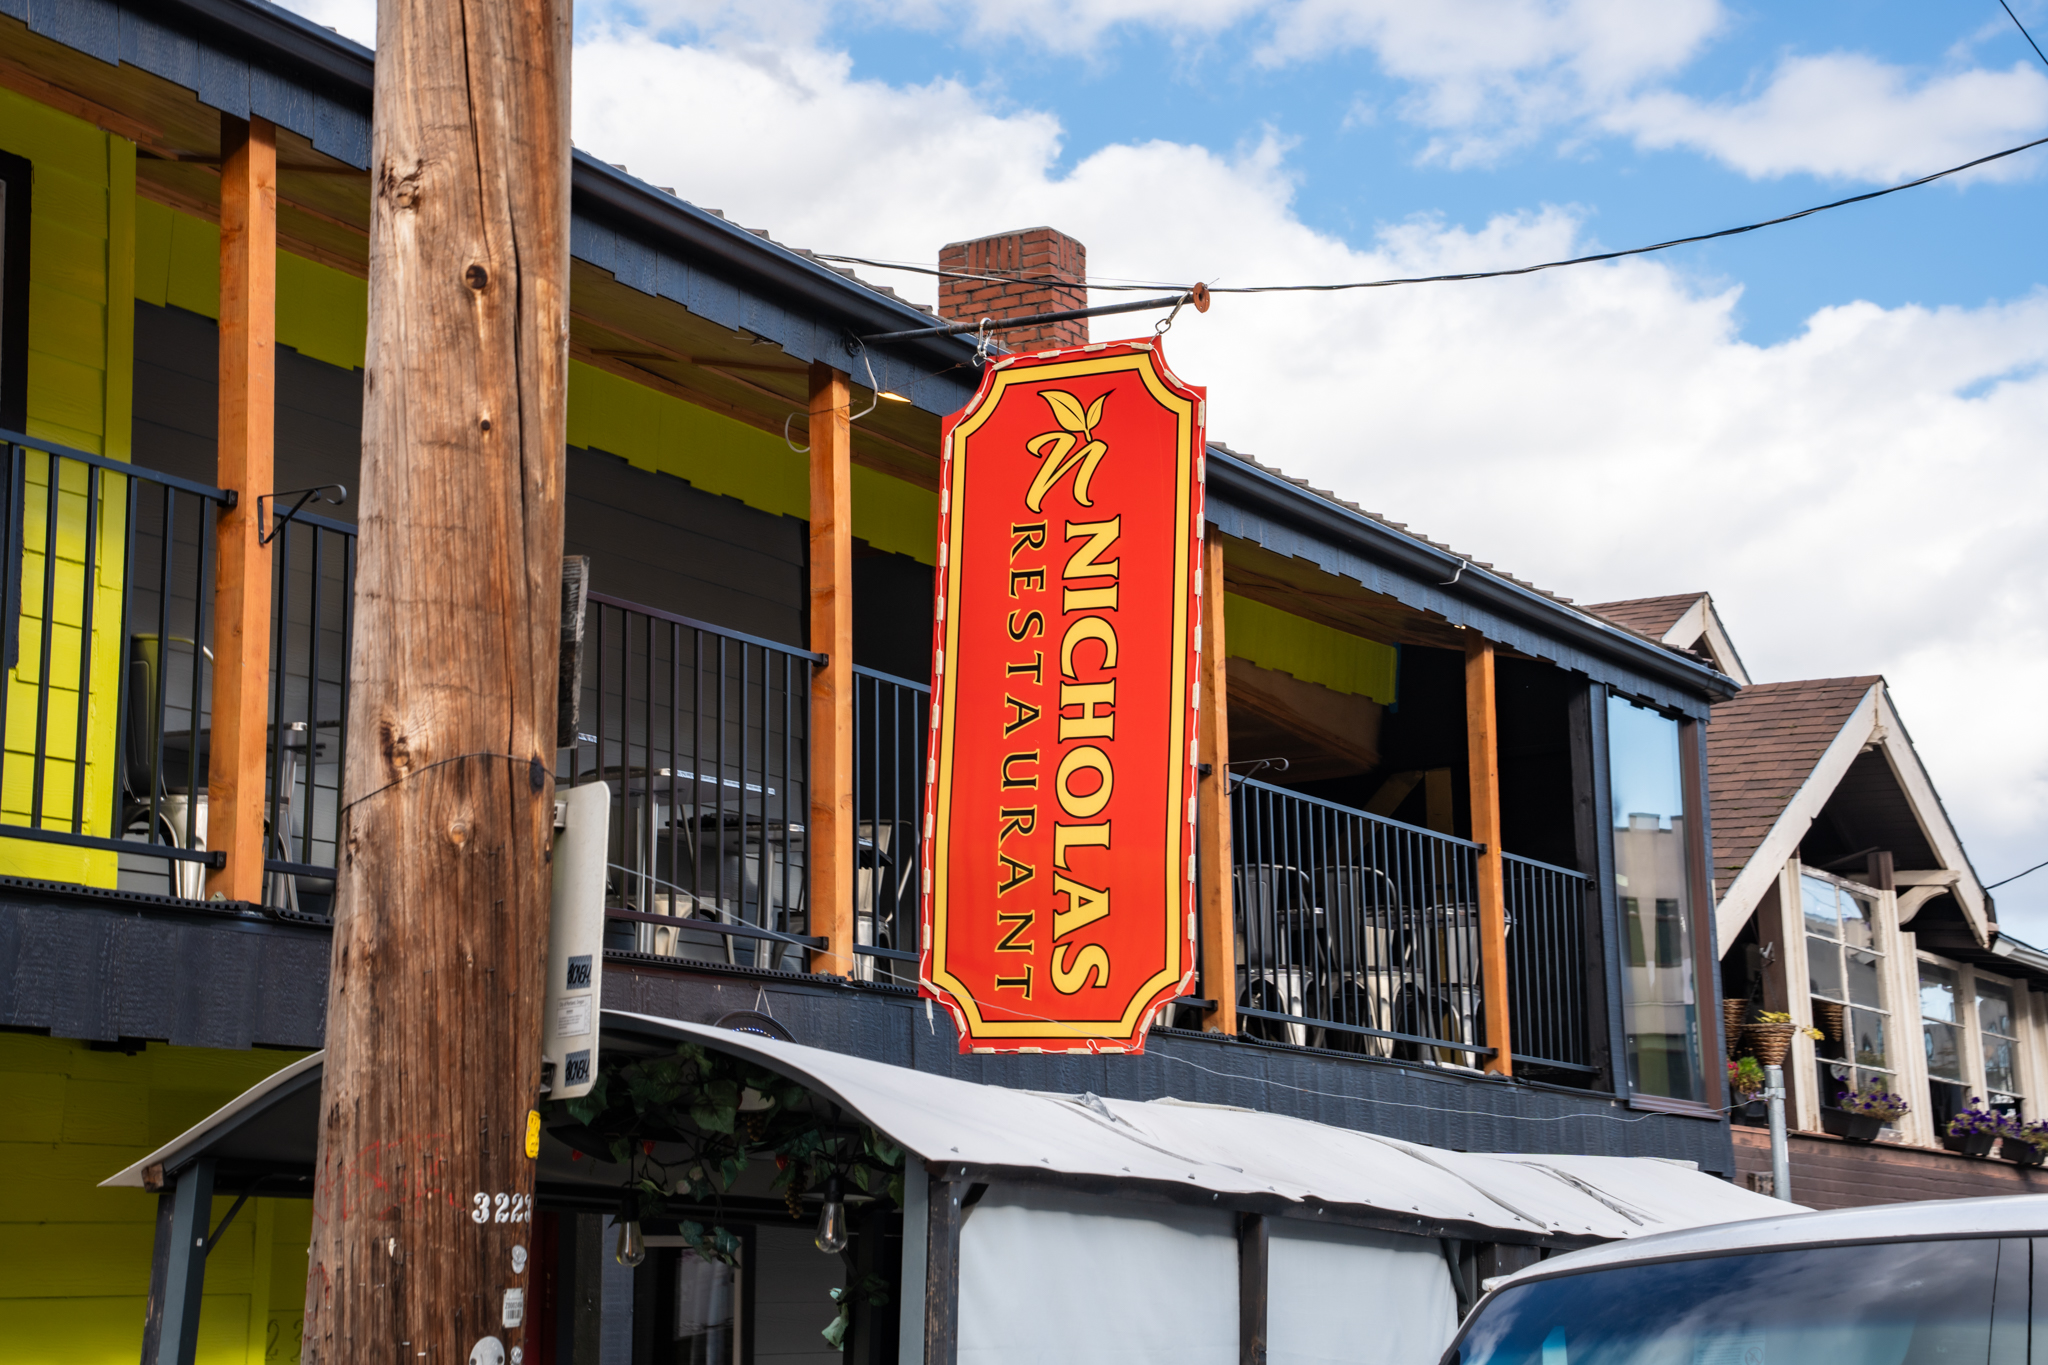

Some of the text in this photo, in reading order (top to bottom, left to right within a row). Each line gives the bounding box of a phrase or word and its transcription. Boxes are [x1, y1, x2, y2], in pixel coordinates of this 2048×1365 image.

[994, 519, 1048, 1000] RESTAURANT
[1050, 513, 1122, 995] NICHOLAS
[471, 1192, 532, 1224] 3223
